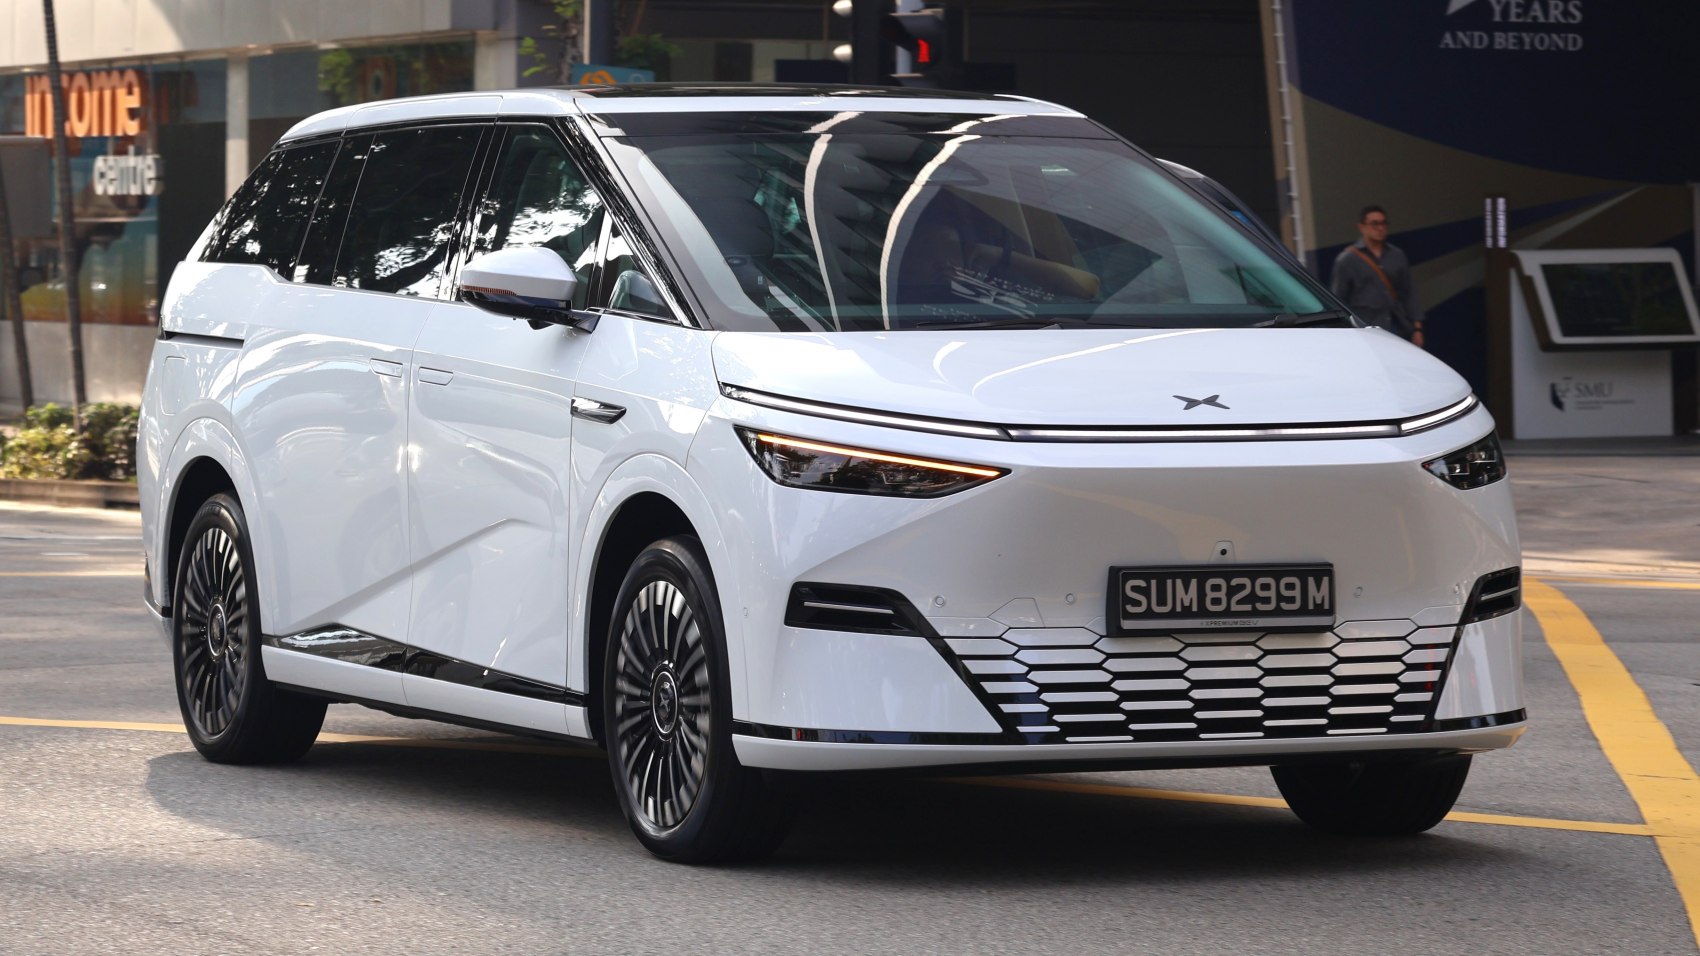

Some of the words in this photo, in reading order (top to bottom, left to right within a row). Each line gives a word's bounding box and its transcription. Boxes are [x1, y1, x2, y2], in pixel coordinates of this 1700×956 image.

[1489, 0, 1583, 24] YEARS
[1440, 31, 1489, 48] AND
[1493, 32, 1583, 51] BEYOND
[93, 146, 160, 196] centre
[1124, 577, 1198, 614] SUM
[1205, 576, 1301, 612] 8299
[1307, 576, 1330, 610] M
